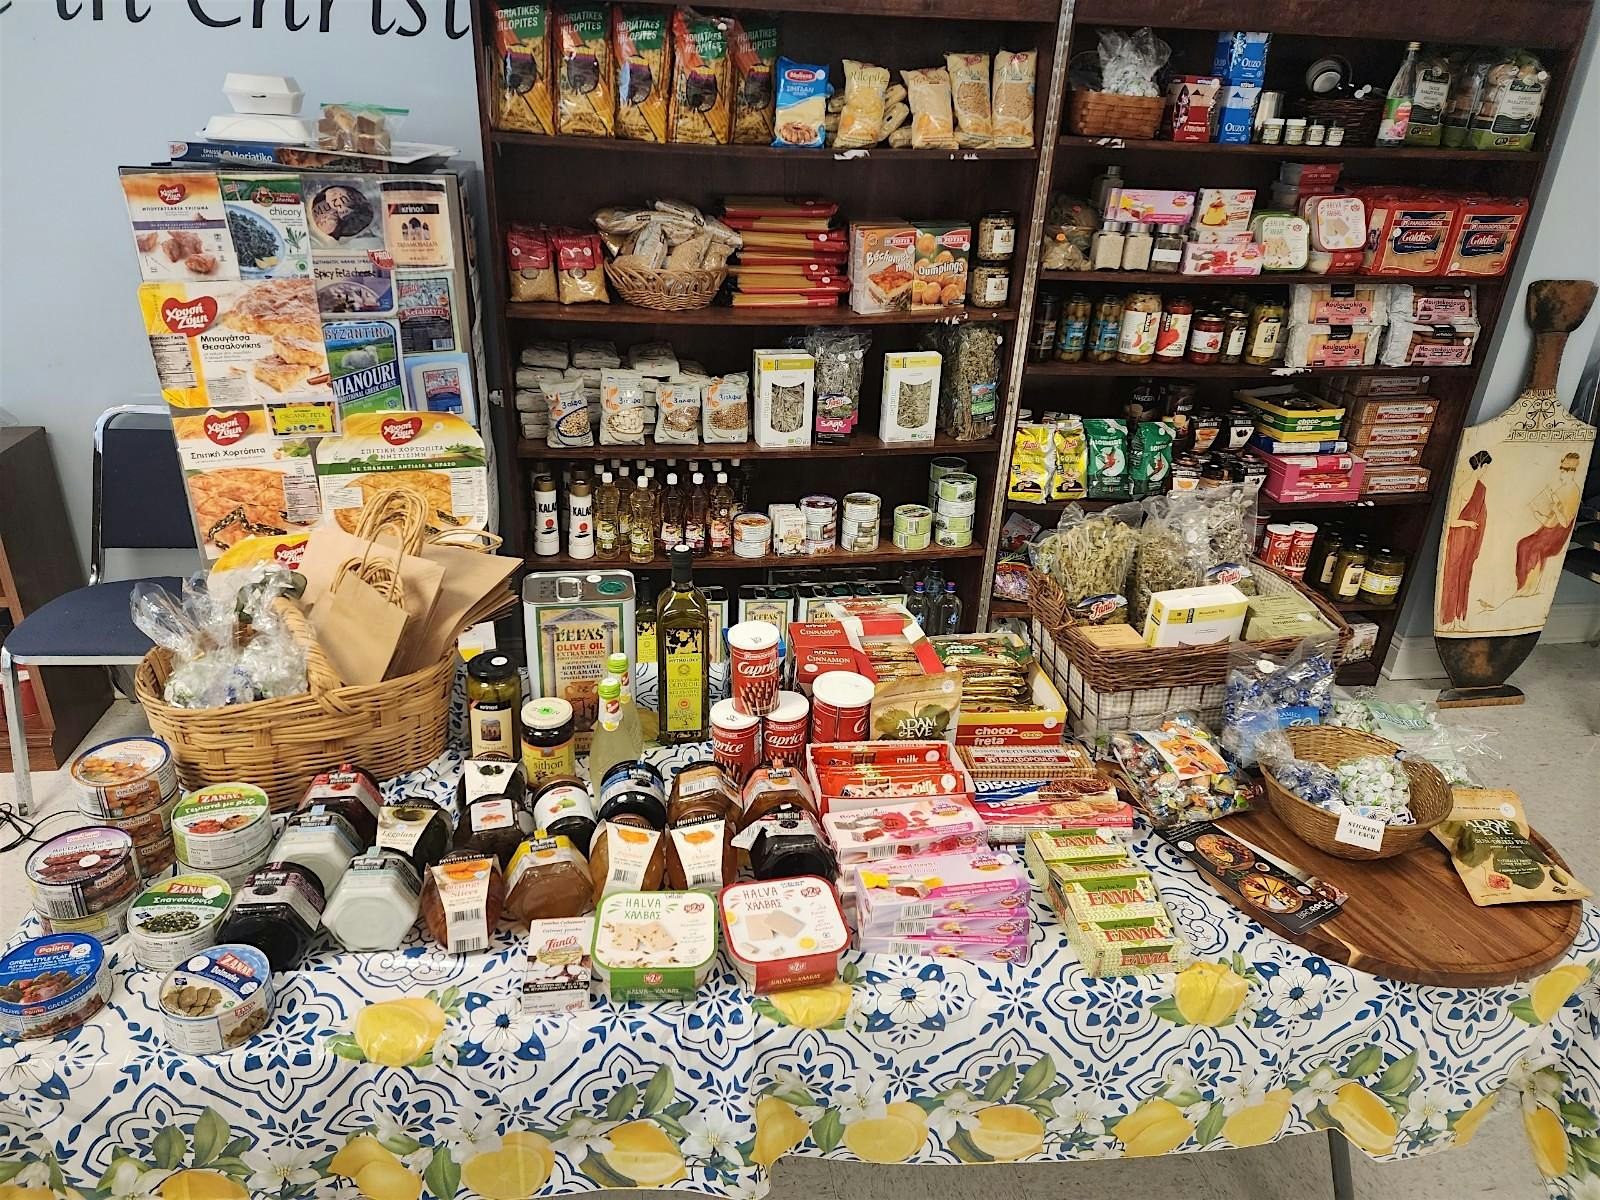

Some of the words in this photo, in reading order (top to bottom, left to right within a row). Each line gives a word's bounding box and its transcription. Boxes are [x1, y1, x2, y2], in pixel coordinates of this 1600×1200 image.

[269, 207, 301, 217] chicory
[1402, 231, 1432, 243] Goldies
[1470, 234, 1499, 247] Goldies
[918, 261, 964, 275] Dumplings
[333, 363, 396, 397] MANOURI
[821, 419, 846, 431] sage
[799, 628, 841, 636] CINNAMON
[557, 643, 586, 651] OLIVE
[589, 642, 605, 650] OIL
[807, 655, 851, 663] CINNAMON
[896, 717, 937, 730] ADAM
[895, 754, 920, 763] milk
[534, 760, 563, 770] sithon
[743, 887, 779, 900] HALVA
[625, 899, 661, 908] HALVA
